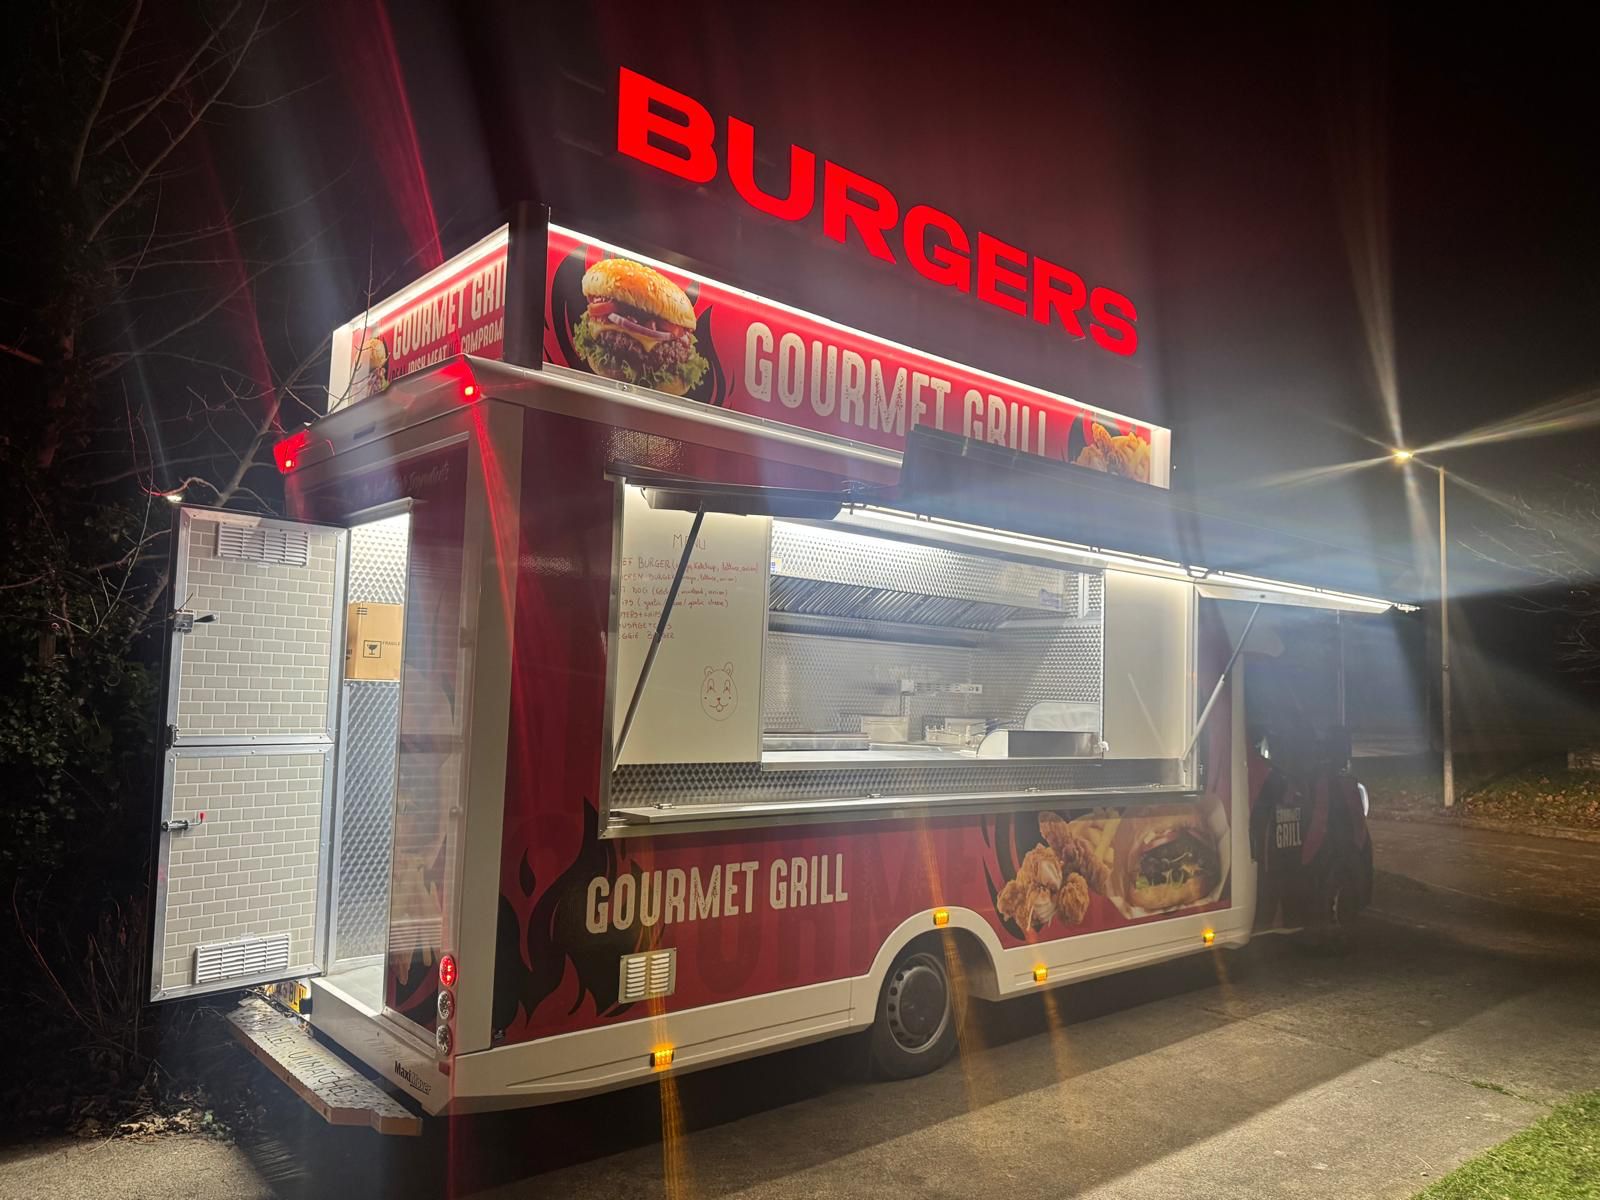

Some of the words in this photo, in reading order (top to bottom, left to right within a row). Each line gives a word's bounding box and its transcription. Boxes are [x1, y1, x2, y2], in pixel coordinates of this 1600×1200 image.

[617, 66, 1138, 357] BURGERS
[393, 284, 467, 360] GOURMET
[471, 260, 507, 320] GRI
[460, 317, 505, 354] COMPROM
[745, 322, 951, 437] GOURMET
[672, 533, 706, 550] MU
[1275, 821, 1303, 849] GRILL
[584, 859, 760, 935] GOURMET
[768, 852, 849, 911] GRILL
